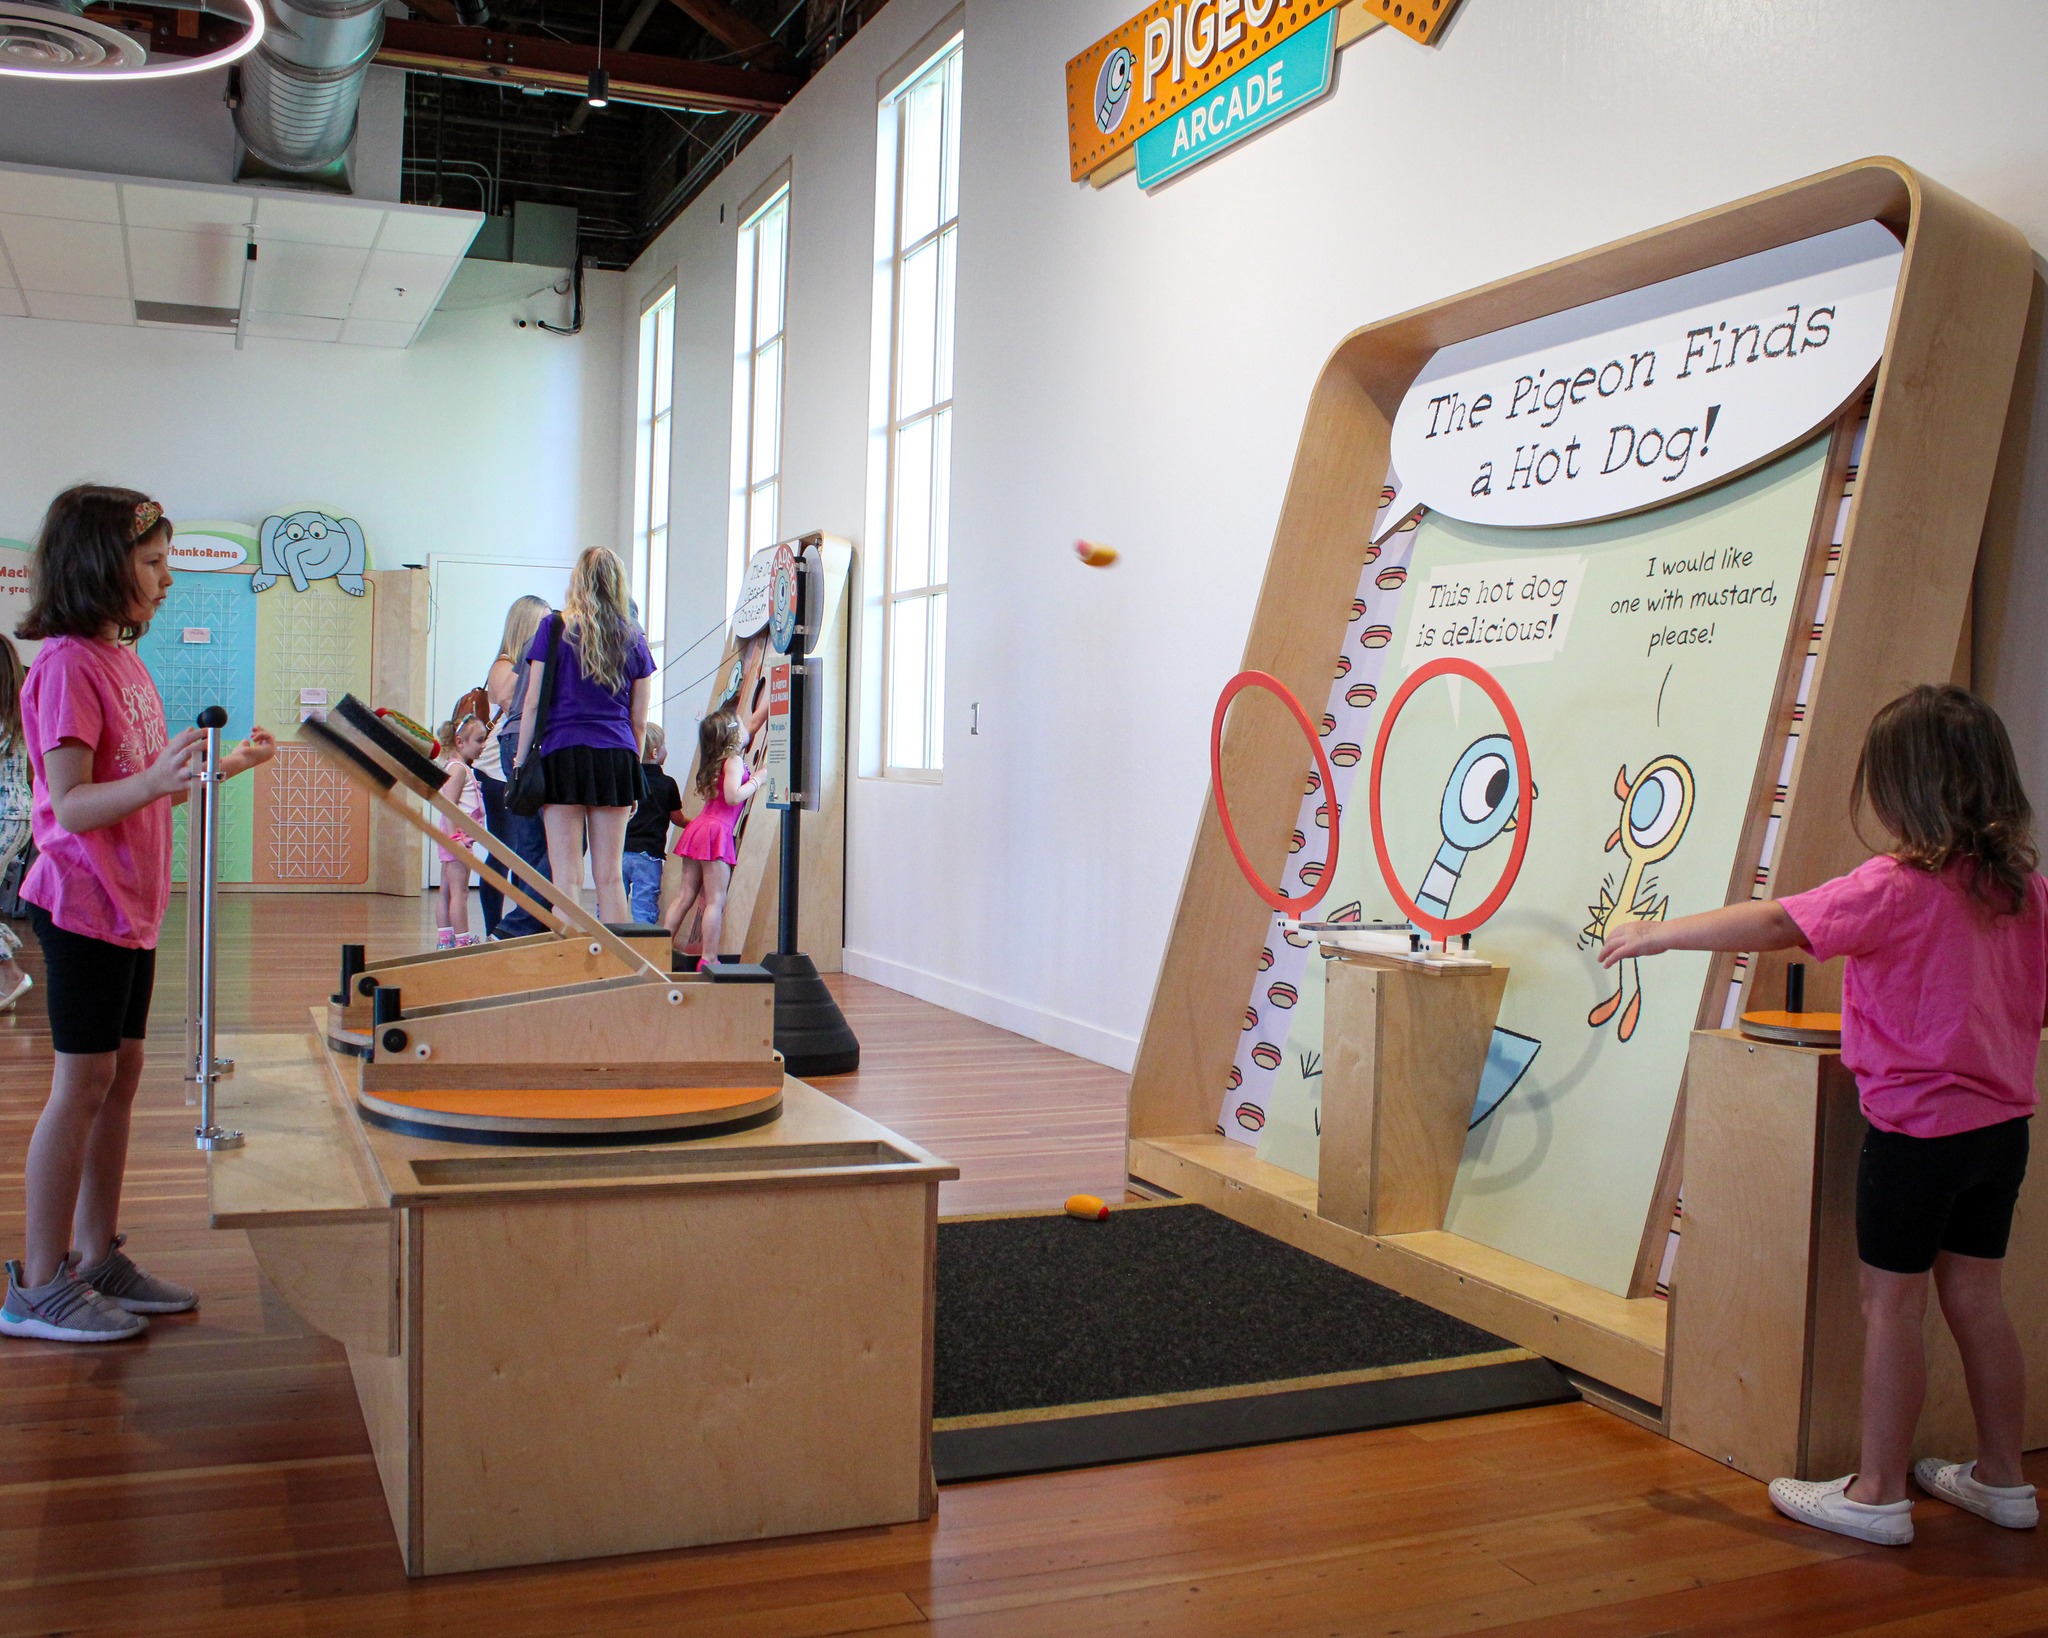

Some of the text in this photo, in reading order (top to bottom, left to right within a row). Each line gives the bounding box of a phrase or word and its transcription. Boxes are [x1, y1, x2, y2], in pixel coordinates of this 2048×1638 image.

[1143, 0, 1289, 103] PIGE
[1171, 59, 1284, 158] ARCADE
[1425, 303, 1836, 439] The Pigeon Finds
[1471, 404, 1721, 497] a Hot Dog!
[1646, 546, 1753, 577] I would like
[1428, 575, 1568, 608] This hot dog
[1610, 579, 1777, 614] one with mustard,
[1415, 613, 1559, 648] is delicious!
[1647, 622, 1715, 657] please!
